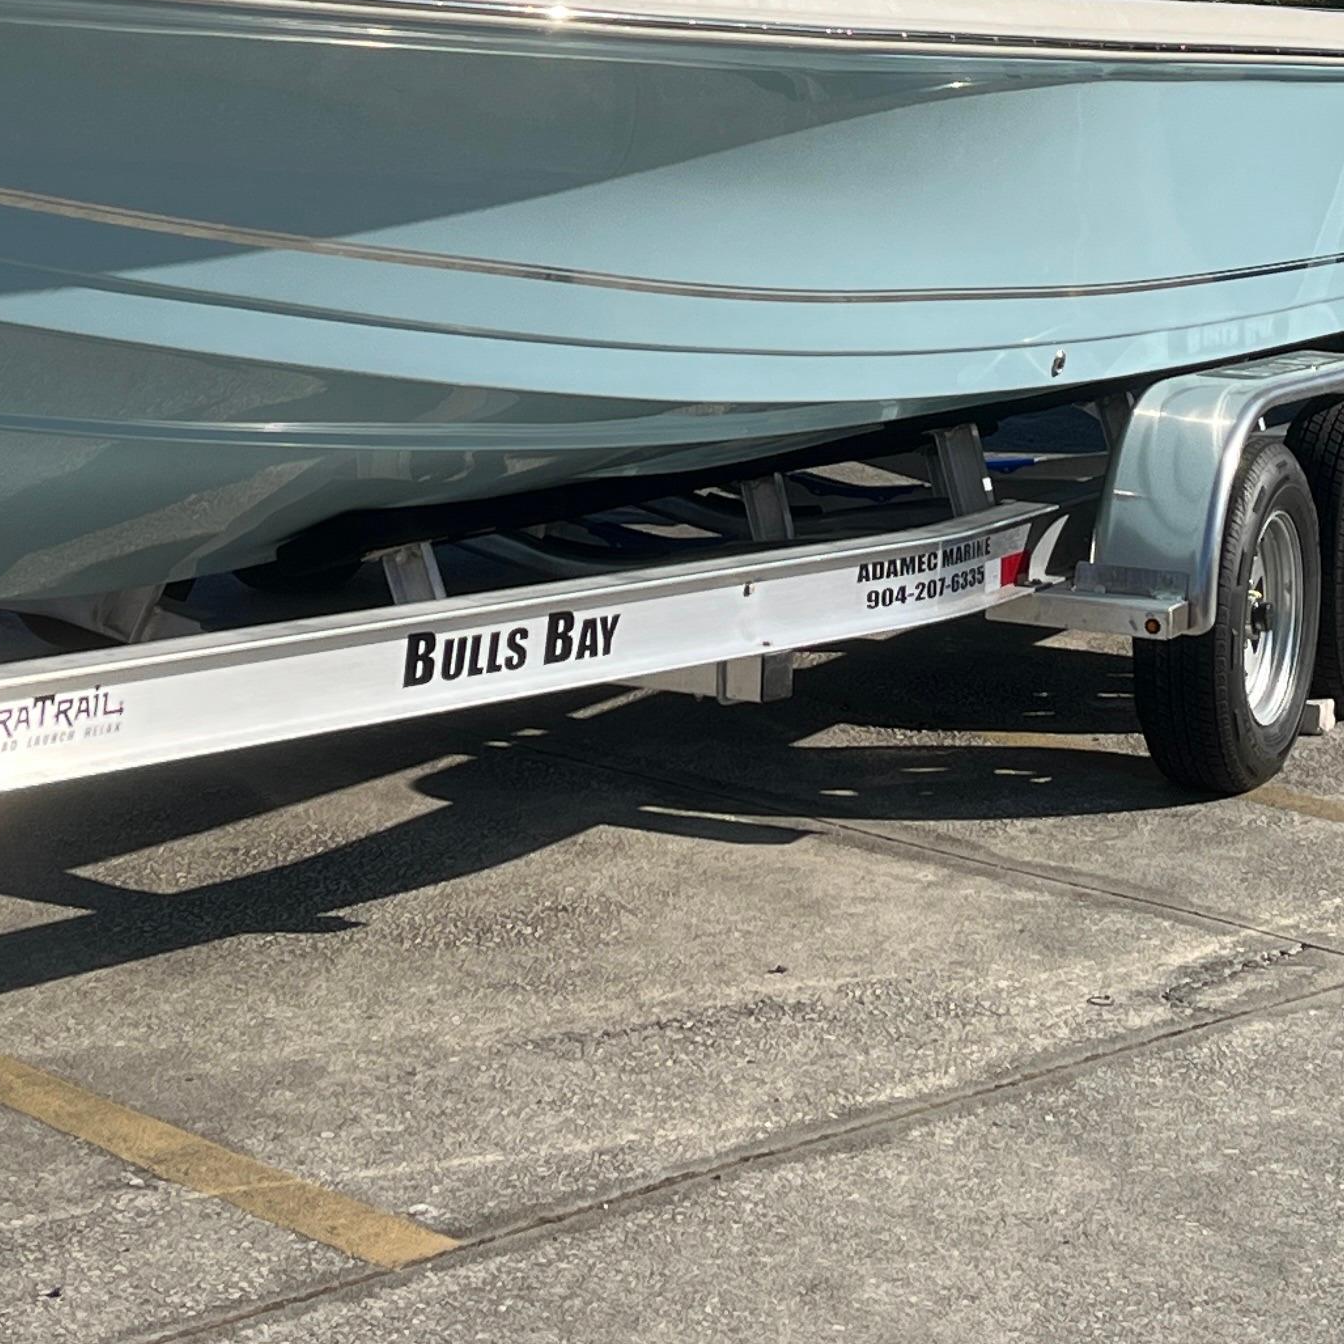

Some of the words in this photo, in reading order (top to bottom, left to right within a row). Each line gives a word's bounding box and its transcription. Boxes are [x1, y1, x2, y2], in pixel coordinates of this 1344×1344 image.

[857, 551, 939, 584] ADAMEC
[941, 536, 992, 569] MARINE
[866, 565, 985, 610] 904-207-6335
[403, 627, 529, 688] BULLS
[543, 610, 621, 665] BAY
